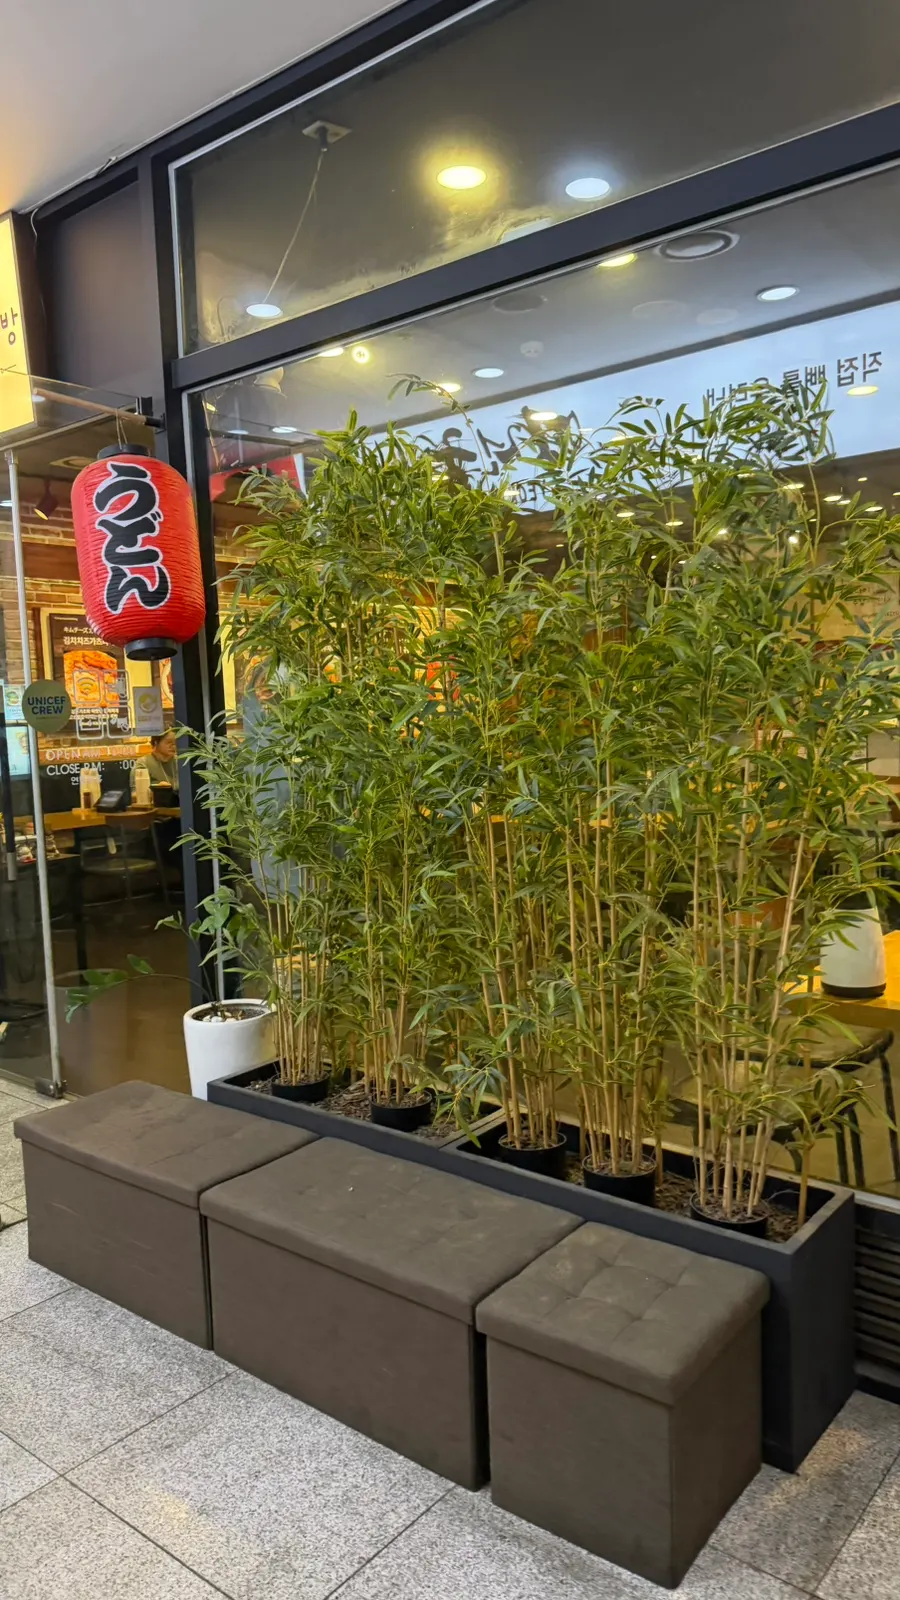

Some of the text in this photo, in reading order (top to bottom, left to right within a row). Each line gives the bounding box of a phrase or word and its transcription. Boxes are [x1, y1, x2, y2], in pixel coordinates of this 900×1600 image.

[94, 461, 171, 614] うどん
[27, 696, 66, 706] UNICEF
[31, 705, 64, 715] CREW
[45, 749, 80, 761] OPEN
[46, 763, 80, 776] CLOSE
